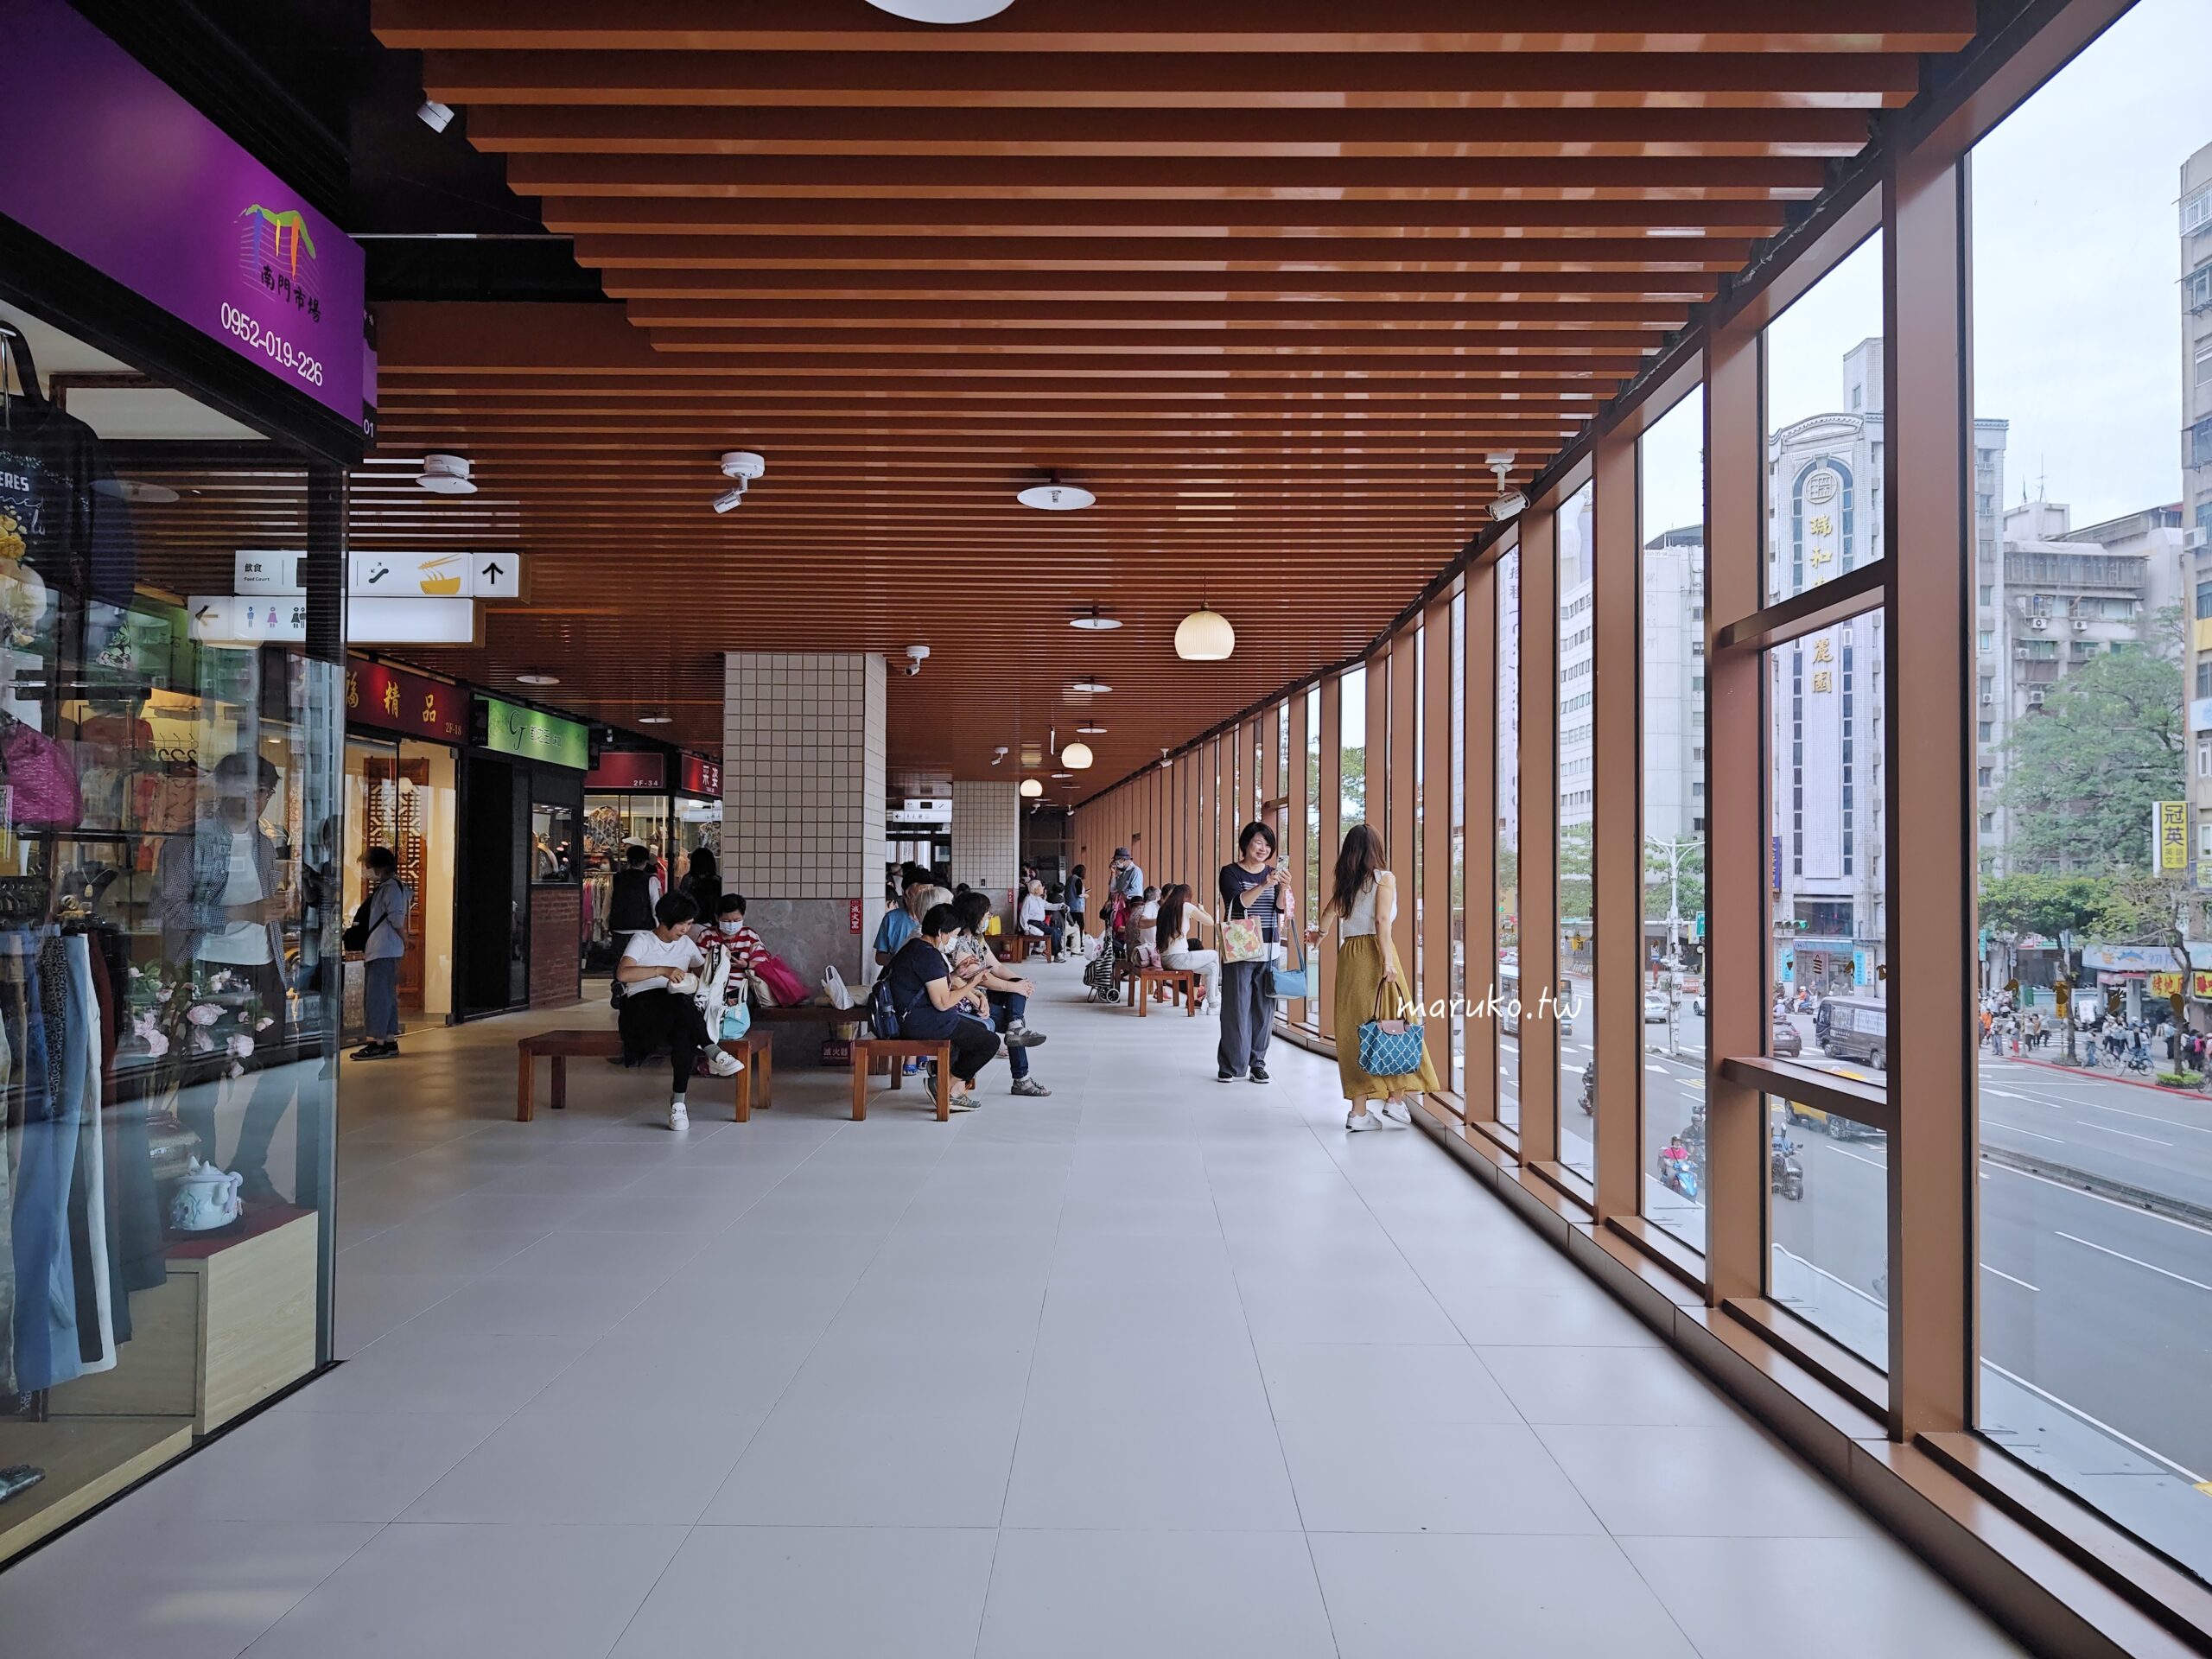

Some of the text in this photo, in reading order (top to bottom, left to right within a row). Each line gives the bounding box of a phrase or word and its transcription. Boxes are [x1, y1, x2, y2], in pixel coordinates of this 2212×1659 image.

[261, 265, 321, 322] 南門市場
[221, 302, 323, 386] 0952-019-226
[245, 563, 262, 572] 飲食
[2164, 804, 2184, 846] 冠英
